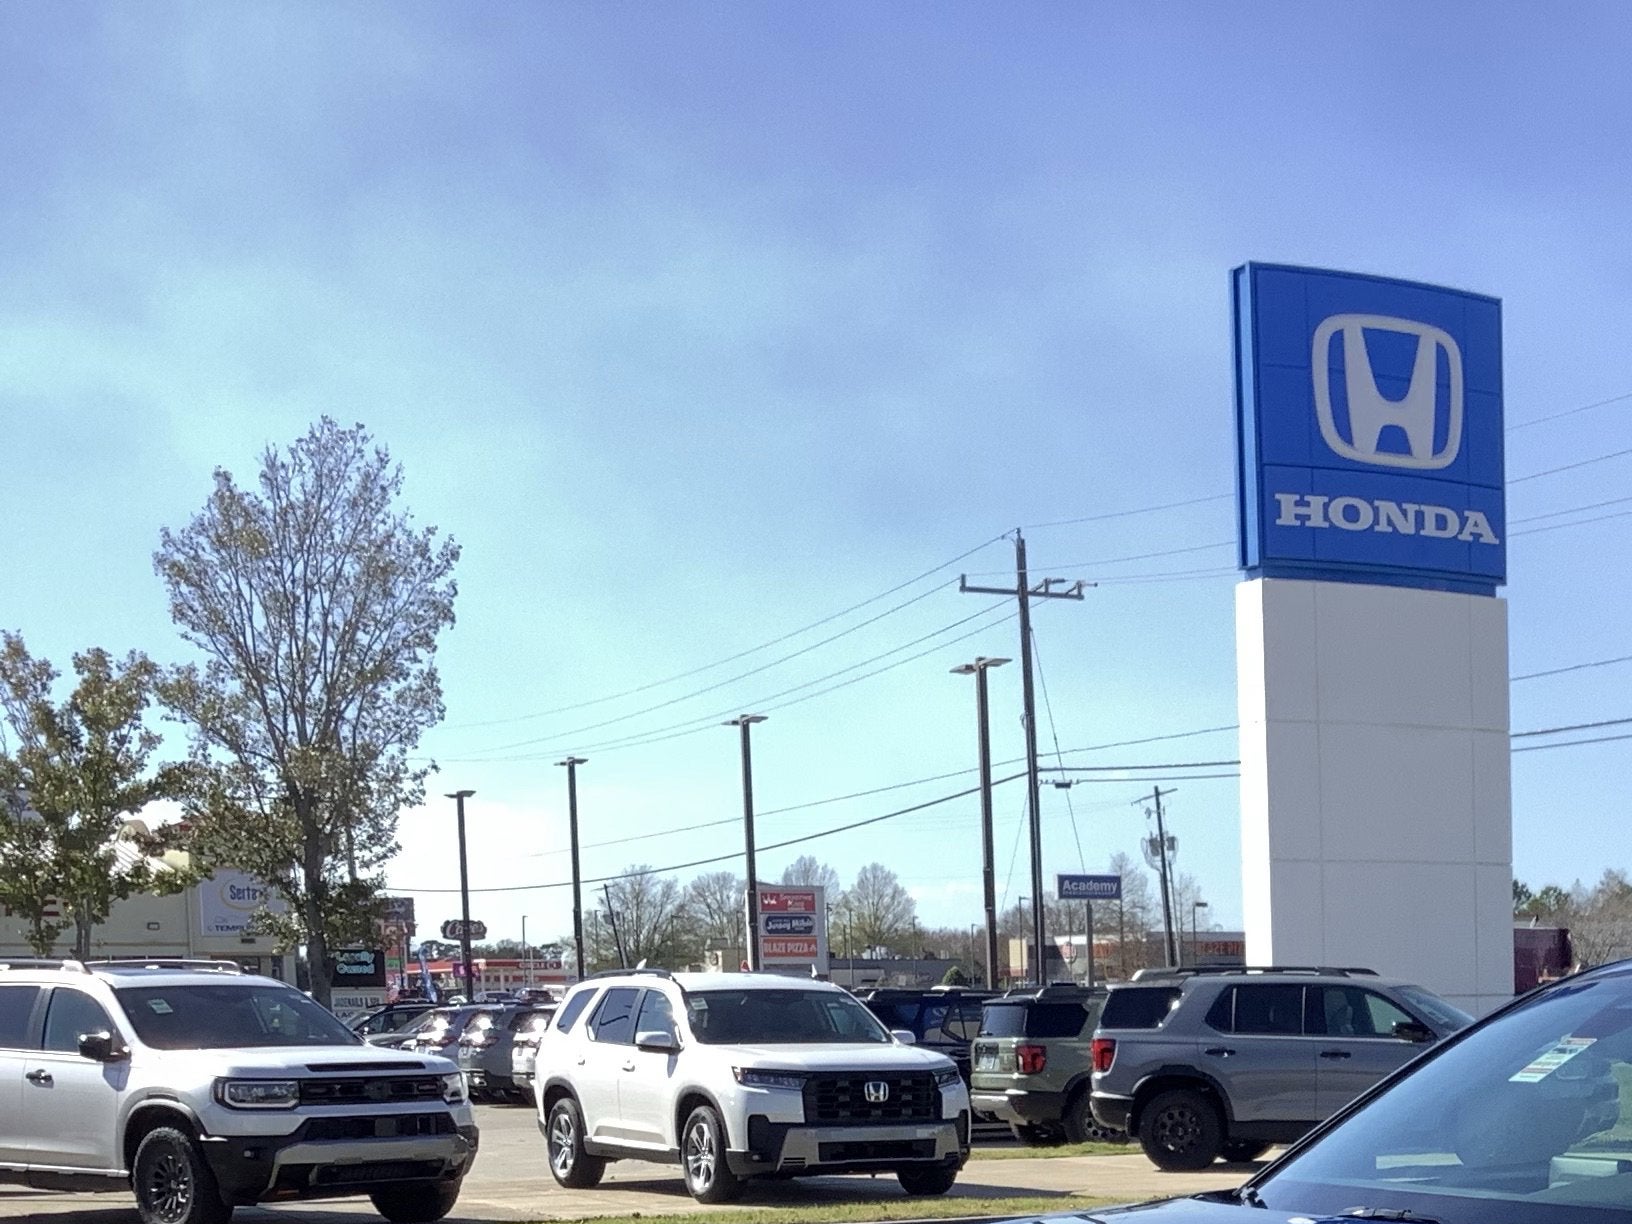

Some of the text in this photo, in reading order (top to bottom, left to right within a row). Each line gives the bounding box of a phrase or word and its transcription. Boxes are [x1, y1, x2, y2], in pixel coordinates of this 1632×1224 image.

[1274, 493, 1499, 544] HONDA
[1063, 880, 1117, 894] Academy
[787, 942, 808, 953] PIZZA
